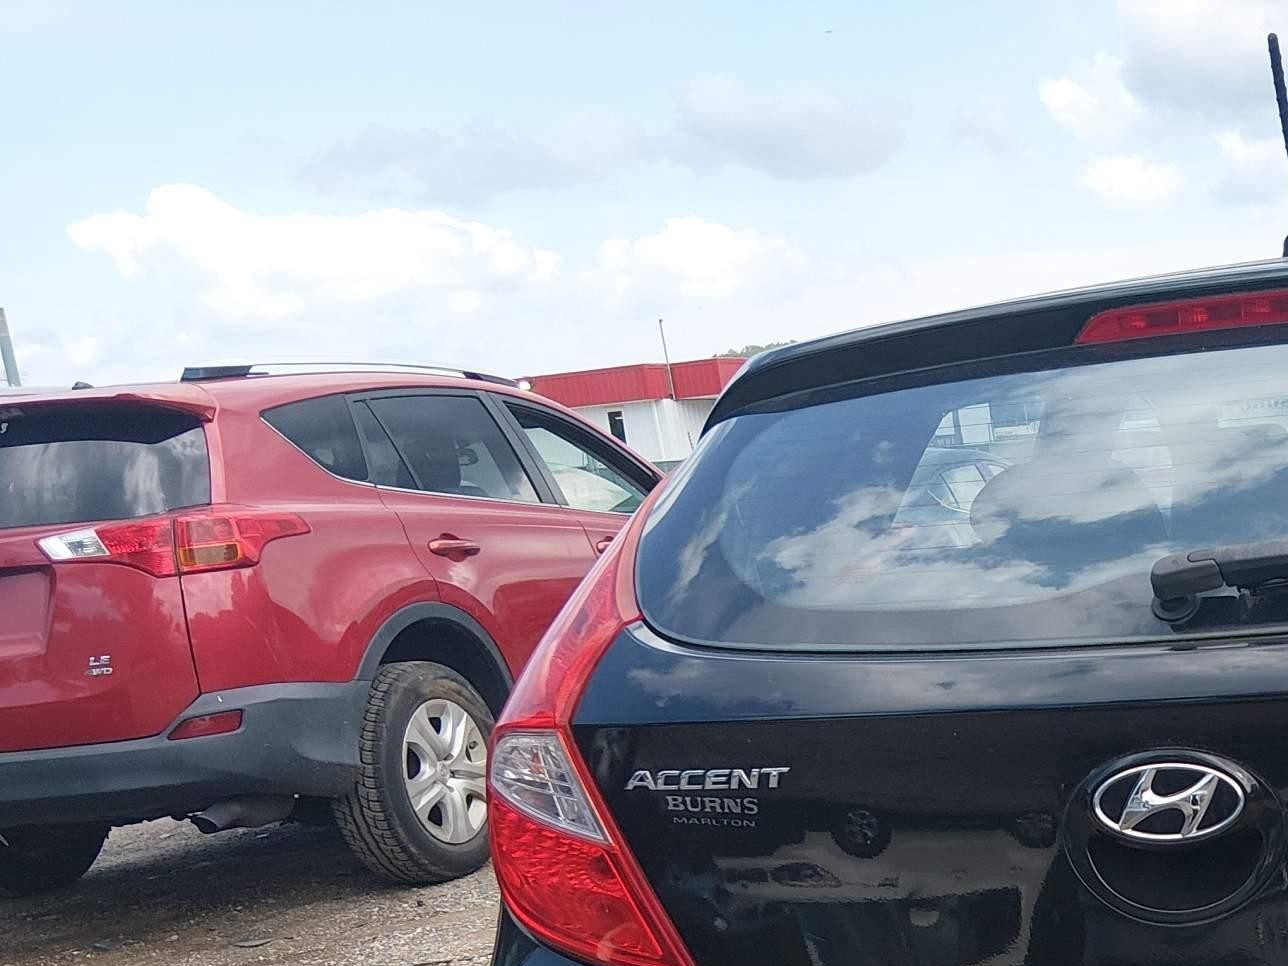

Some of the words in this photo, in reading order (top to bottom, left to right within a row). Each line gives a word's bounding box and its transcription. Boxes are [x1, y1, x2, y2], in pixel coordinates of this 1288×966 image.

[89, 655, 111, 666] LE
[624, 767, 791, 790] ACCENT
[666, 795, 758, 814] BURNS
[673, 816, 756, 827] MARLTON
